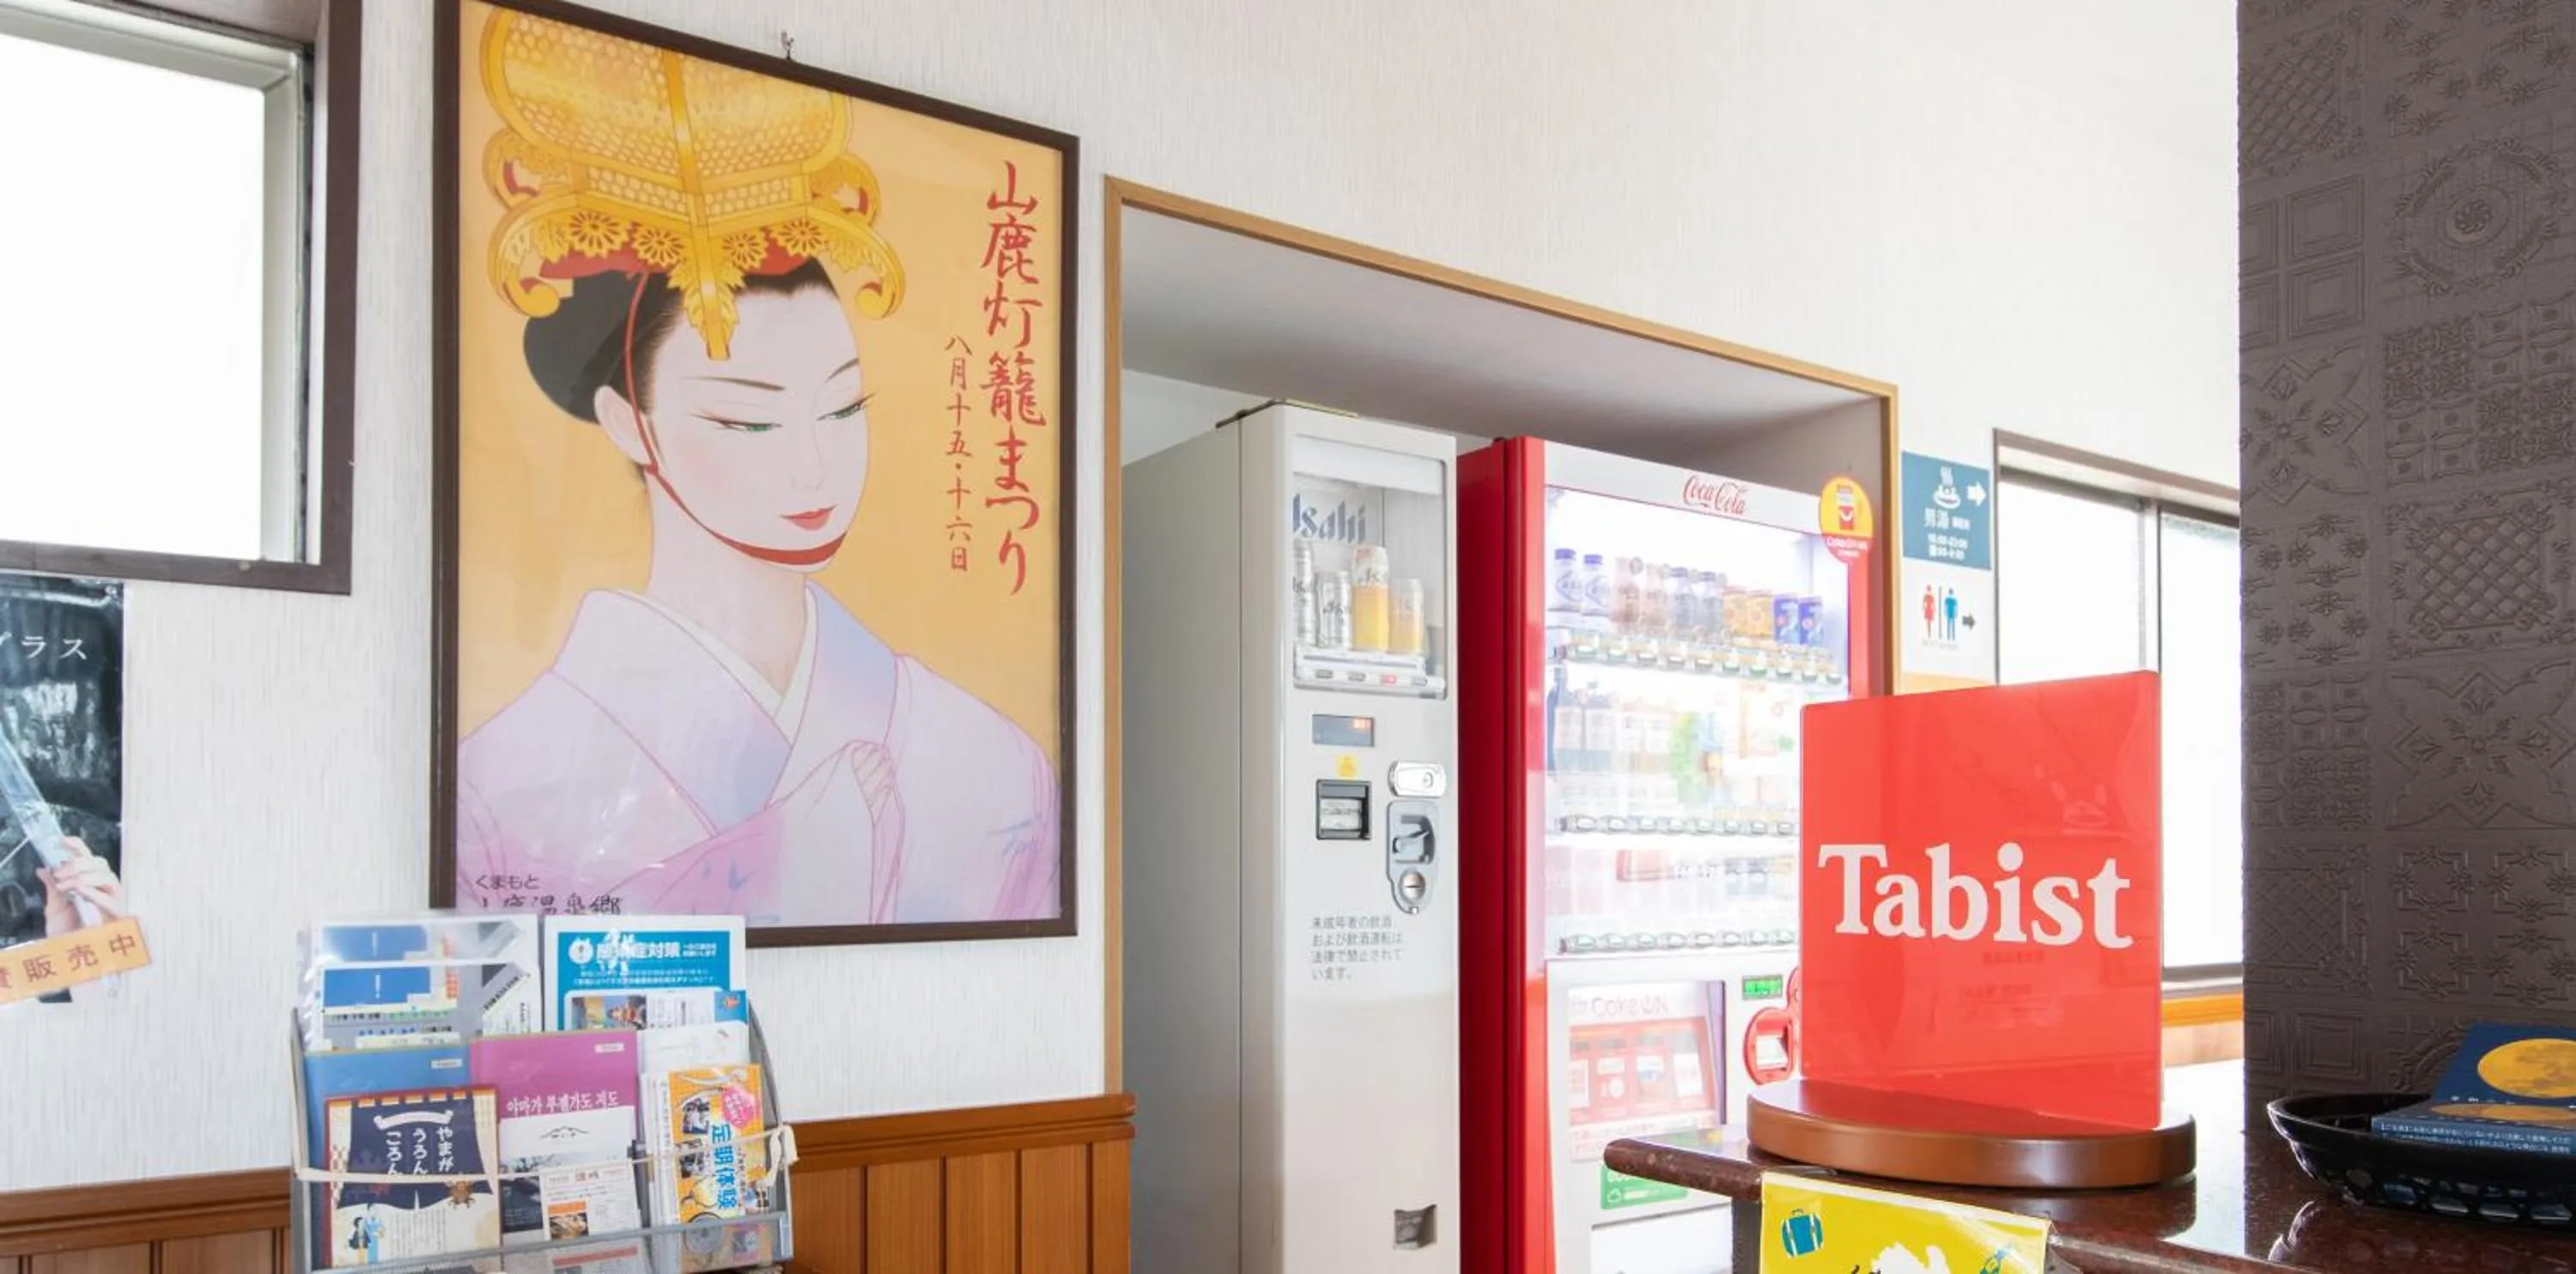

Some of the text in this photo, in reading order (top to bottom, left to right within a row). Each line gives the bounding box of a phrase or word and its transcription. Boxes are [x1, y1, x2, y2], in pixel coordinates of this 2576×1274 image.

[980, 161, 1047, 596] 山鹿灯籠まつり
[476, 874, 540, 890] くまもと
[1816, 841, 2135, 949] Tabist
[1310, 915, 1393, 929] 未成年者の飲酒
[1311, 931, 1403, 946] および飲酒運転は
[436, 1126, 454, 1173] やまが
